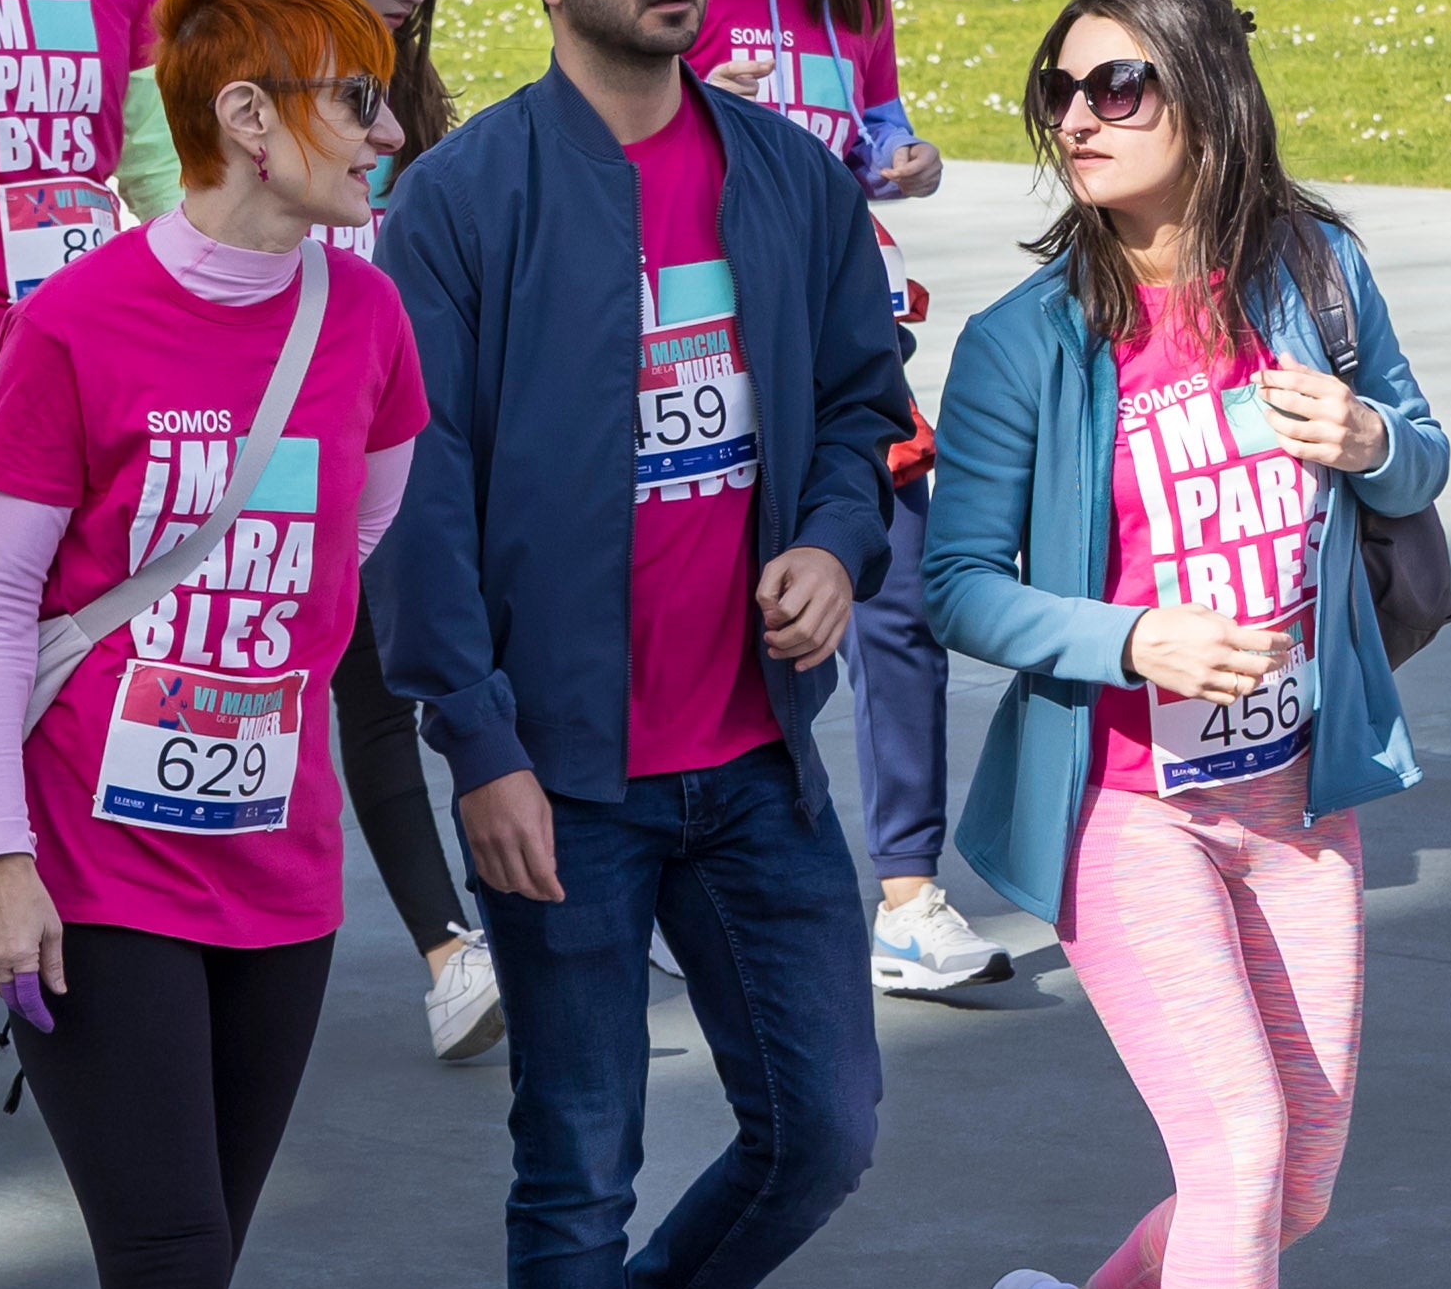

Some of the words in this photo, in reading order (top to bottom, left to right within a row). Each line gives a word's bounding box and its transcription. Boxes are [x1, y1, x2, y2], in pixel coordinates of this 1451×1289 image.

[650, 329, 731, 366] MARCHA
[651, 366, 663, 375] DE
[664, 364, 675, 373] LA
[675, 353, 735, 386] MUJER
[1119, 373, 1209, 420] SOMOS
[147, 410, 231, 433] SOMOS
[1174, 455, 1337, 551] PARA
[130, 591, 298, 669] BLES
[194, 686, 217, 712] VI
[220, 688, 283, 716] MARCHA
[1200, 677, 1300, 747] 456
[238, 711, 281, 740] MUJER
[156, 737, 266, 797] 629
